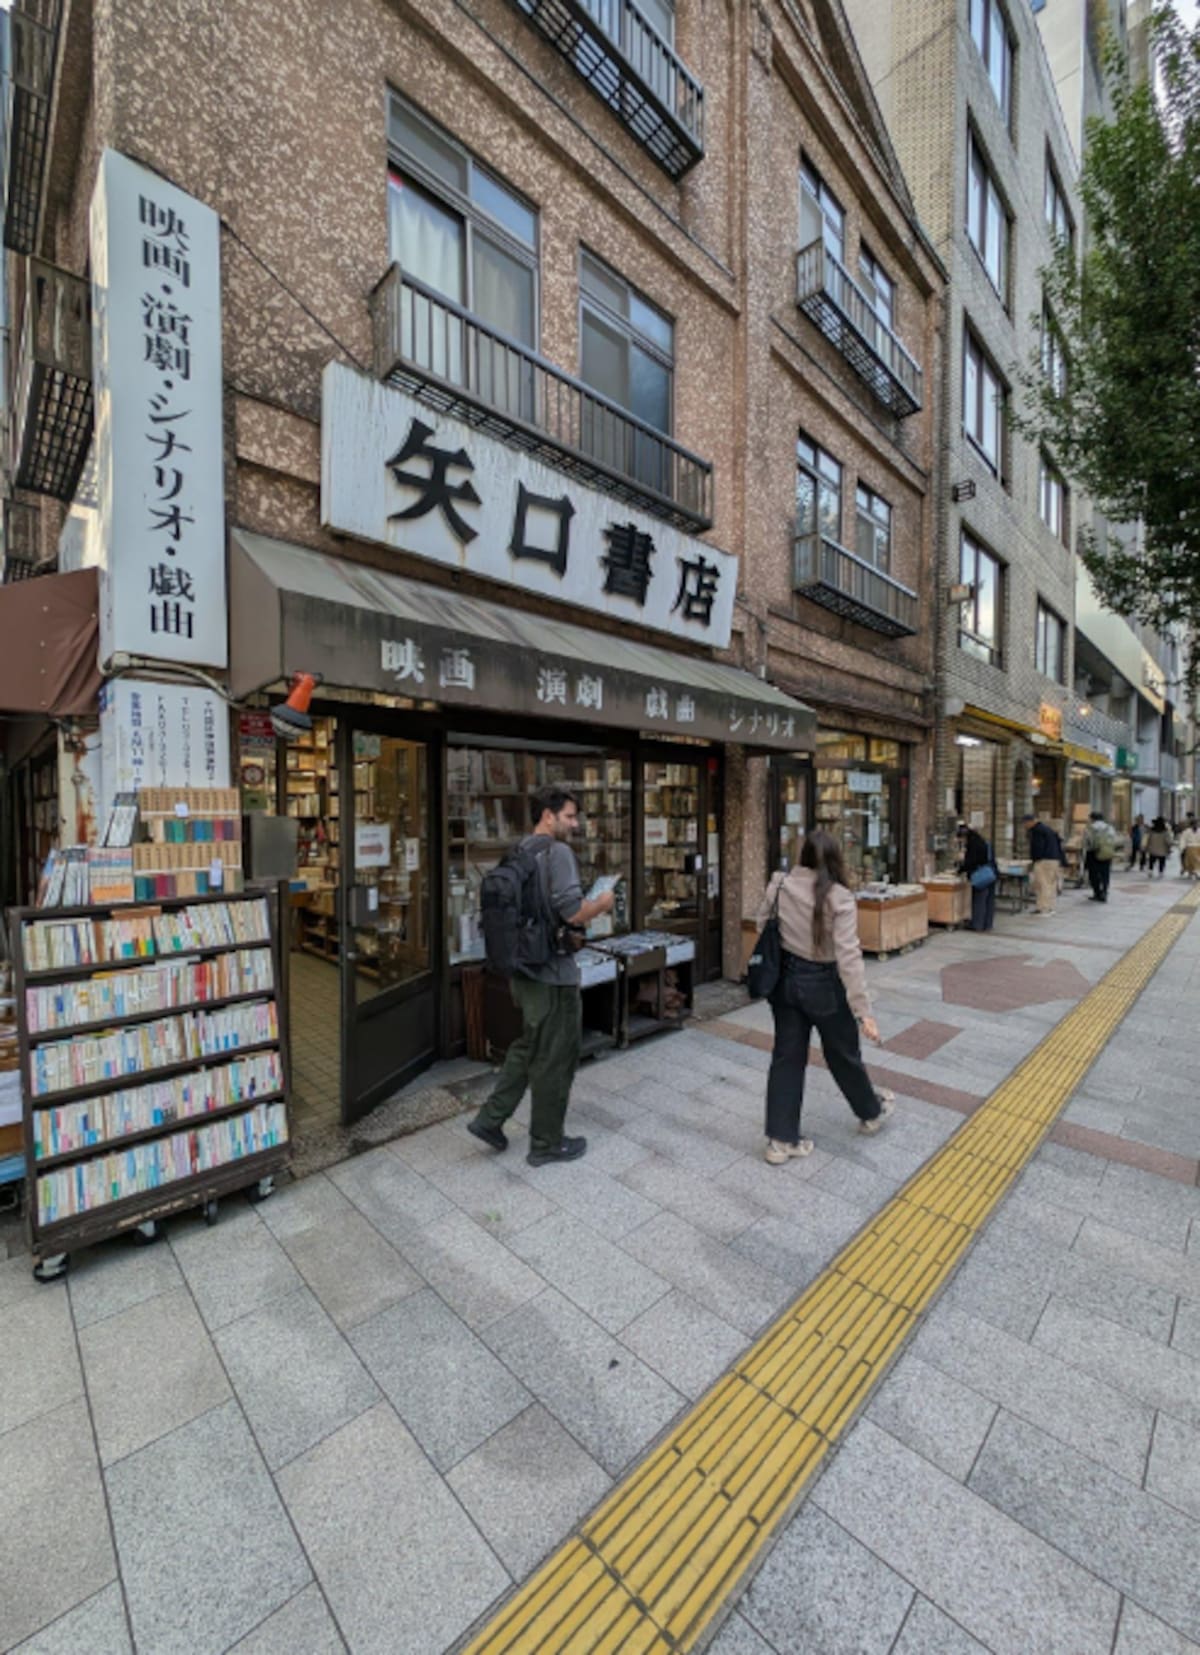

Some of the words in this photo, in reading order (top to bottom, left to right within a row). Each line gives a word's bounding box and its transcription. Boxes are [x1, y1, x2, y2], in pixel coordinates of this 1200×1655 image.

[385, 417, 721, 626] 矢口書店
[380, 637, 476, 691] 映画
[536, 666, 604, 711] 演劇
[644, 686, 696, 723] 戯曲
[728, 707, 796, 739] シナリオ
